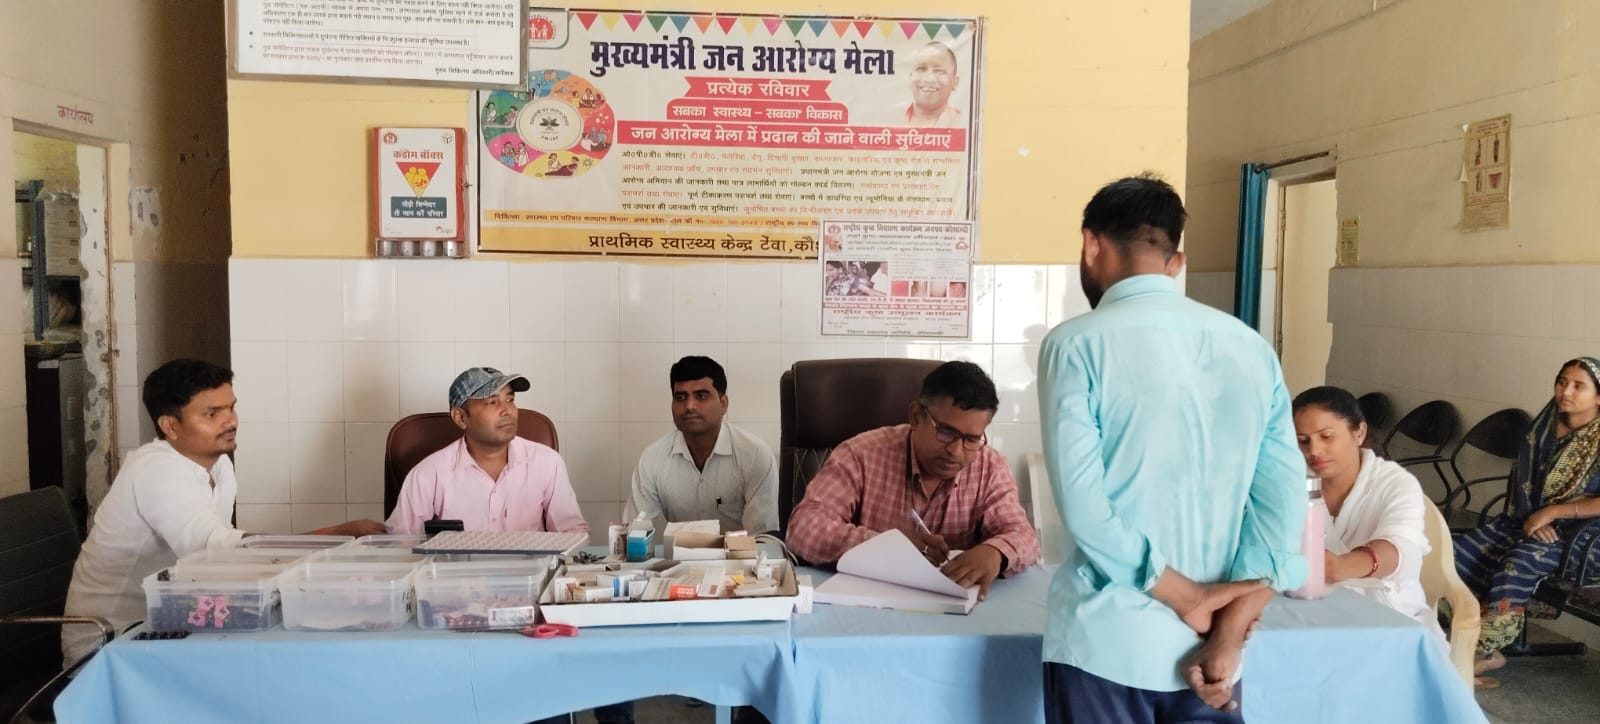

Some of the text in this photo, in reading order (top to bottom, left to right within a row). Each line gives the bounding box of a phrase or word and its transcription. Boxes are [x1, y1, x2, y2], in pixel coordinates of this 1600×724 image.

[590, 36, 895, 77] मुख्यमंत्री जन आरोग्य मेला
[707, 79, 810, 97] प्रत्येक रविवार
[672, 105, 706, 118] सबका
[712, 106, 752, 119] स्वास्थ्य
[806, 108, 843, 121] विकास
[631, 123, 951, 150] जन आरोग्य मेला में प्रदान की जाने वाली सुविधाएं
[588, 231, 653, 249] प्राथमिक
[661, 236, 715, 250] स्वास्थ्य
[721, 233, 752, 252] केन्द्र
